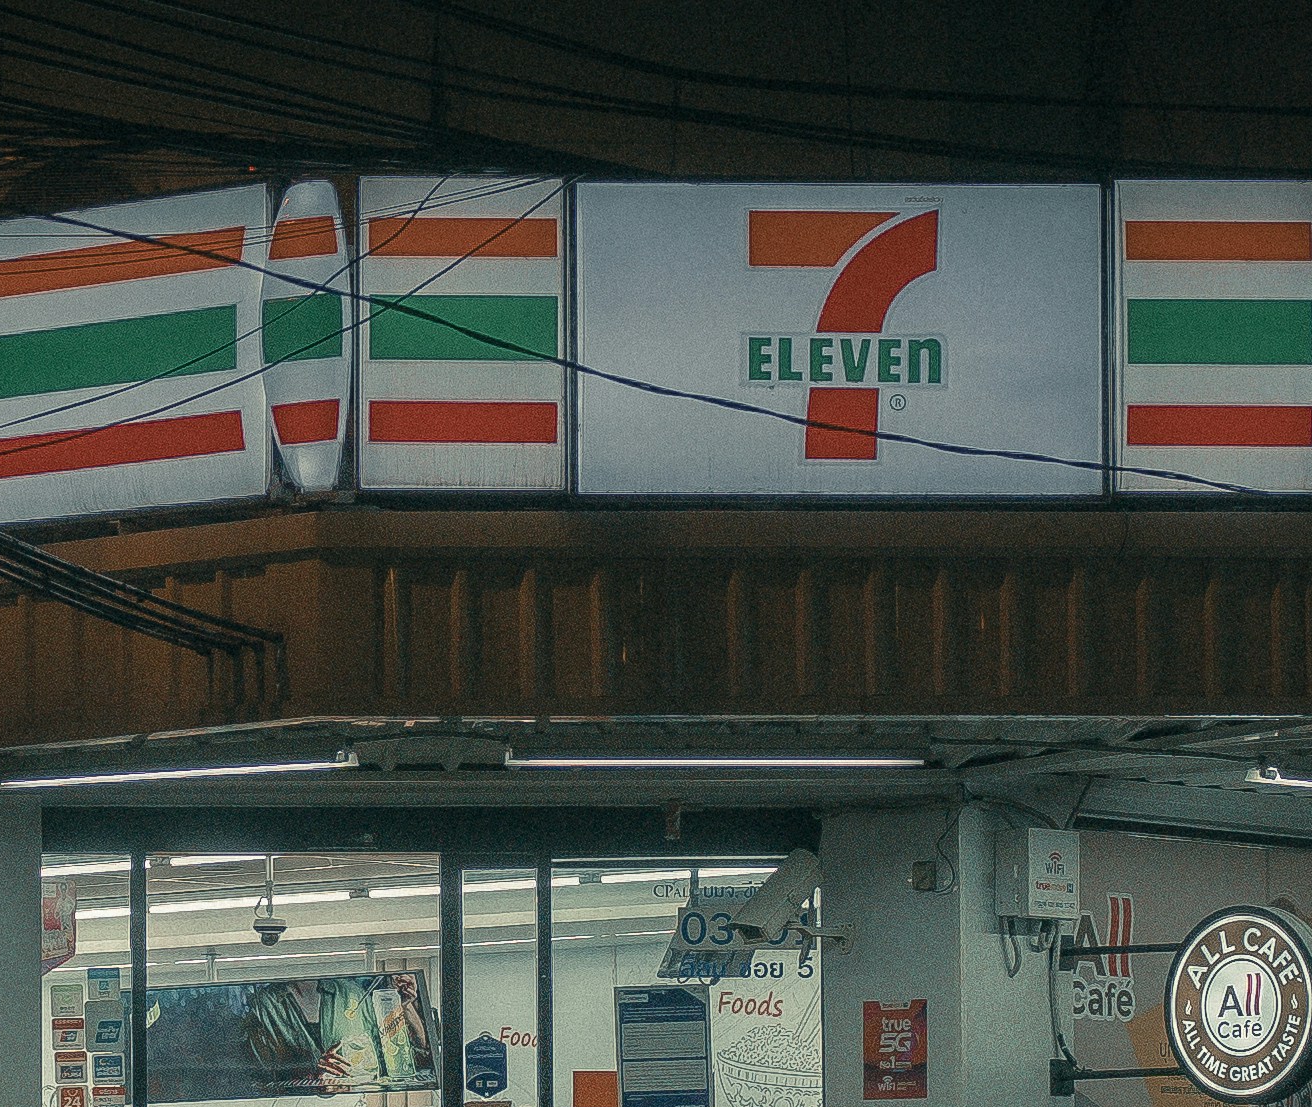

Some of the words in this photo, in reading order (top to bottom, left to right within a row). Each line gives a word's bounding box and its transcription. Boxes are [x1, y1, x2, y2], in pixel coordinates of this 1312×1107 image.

[797, 955, 814, 979] 5
[1187, 930, 1237, 990] ALL
[718, 991, 784, 1018] Foods
[1218, 972, 1262, 1018] All
[882, 1018, 911, 1031] true
[1218, 1017, 1263, 1039] Café
[879, 1032, 912, 1053] 5G
[1182, 1019, 1198, 1050] ALL
[1196, 1045, 1229, 1080] TIME
[1229, 1055, 1274, 1082] GREAT
[1271, 1014, 1302, 1062] TASTE
